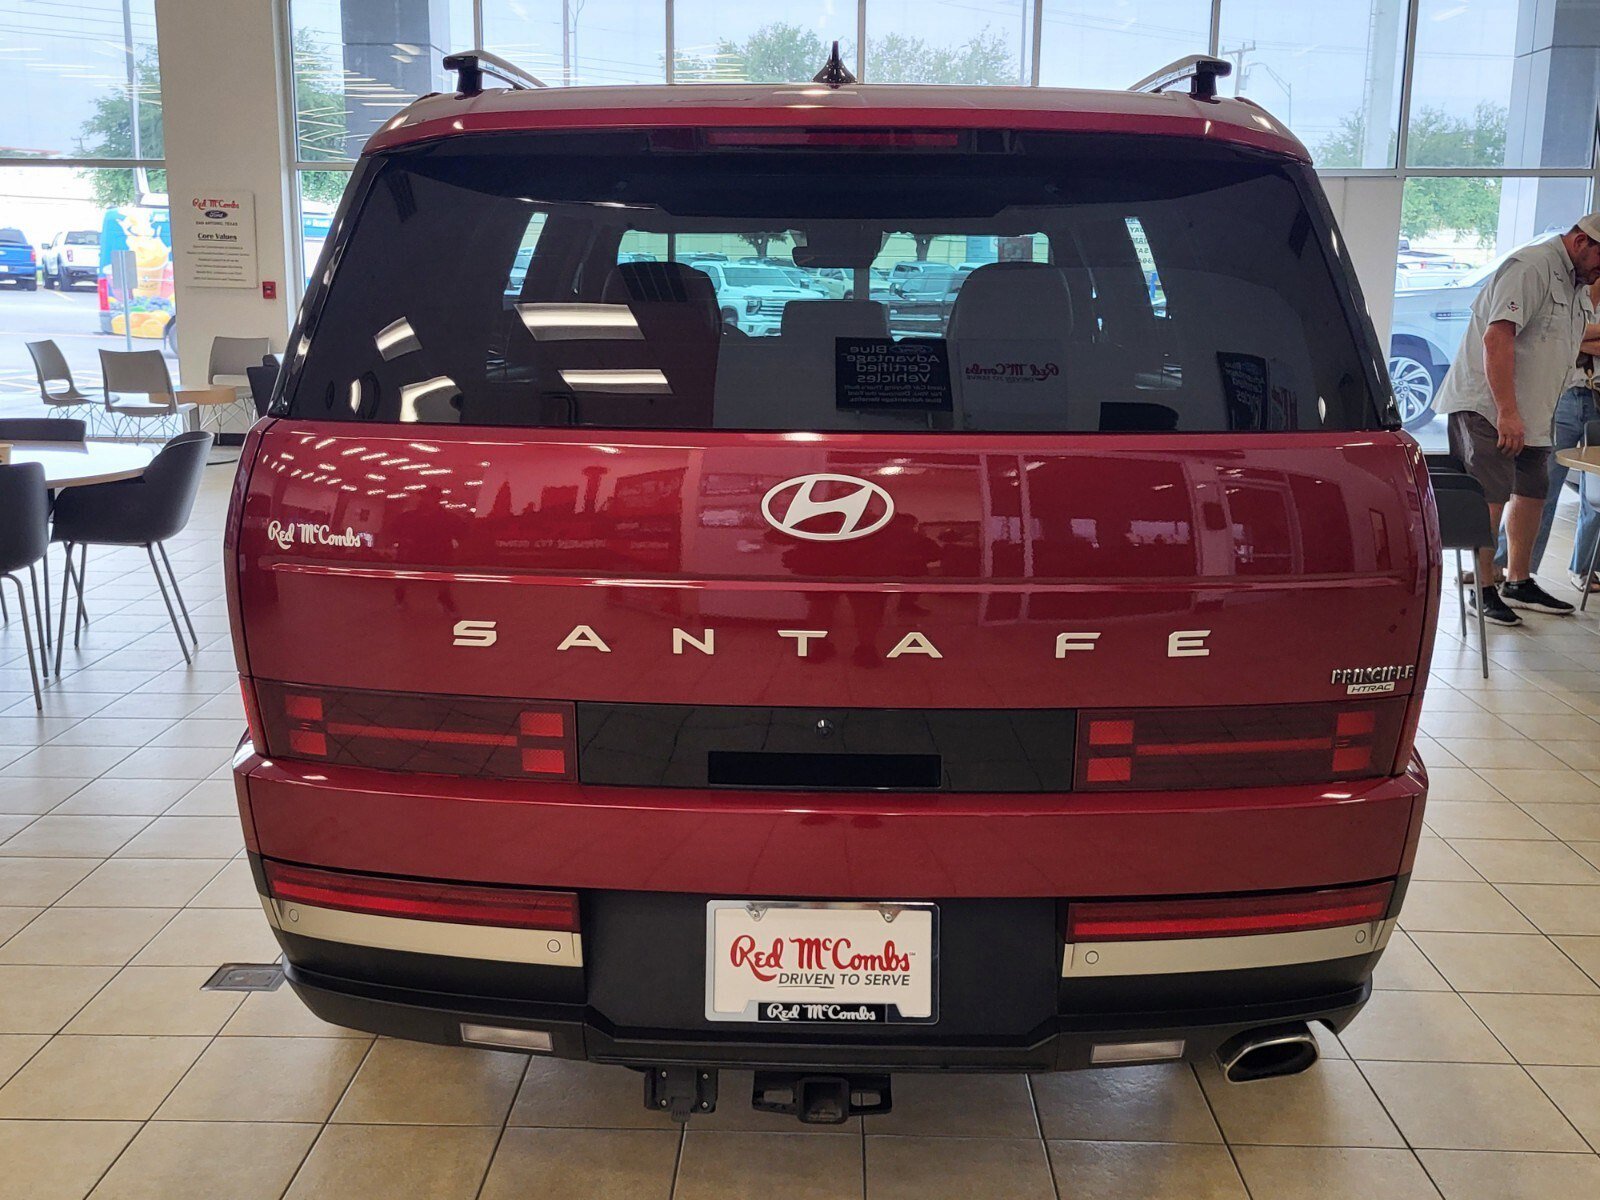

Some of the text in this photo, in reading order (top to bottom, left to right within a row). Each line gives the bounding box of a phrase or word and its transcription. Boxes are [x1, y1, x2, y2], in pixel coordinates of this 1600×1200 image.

[268, 520, 361, 550] Red McCombs
[453, 620, 1211, 659] SANTA FE
[1351, 683, 1393, 693] HTRAC
[730, 935, 784, 982] Red
[789, 937, 910, 972] McCombs
[778, 973, 911, 986] DRIVEN TO SERVE
[767, 1003, 876, 1022] Red McCombs
